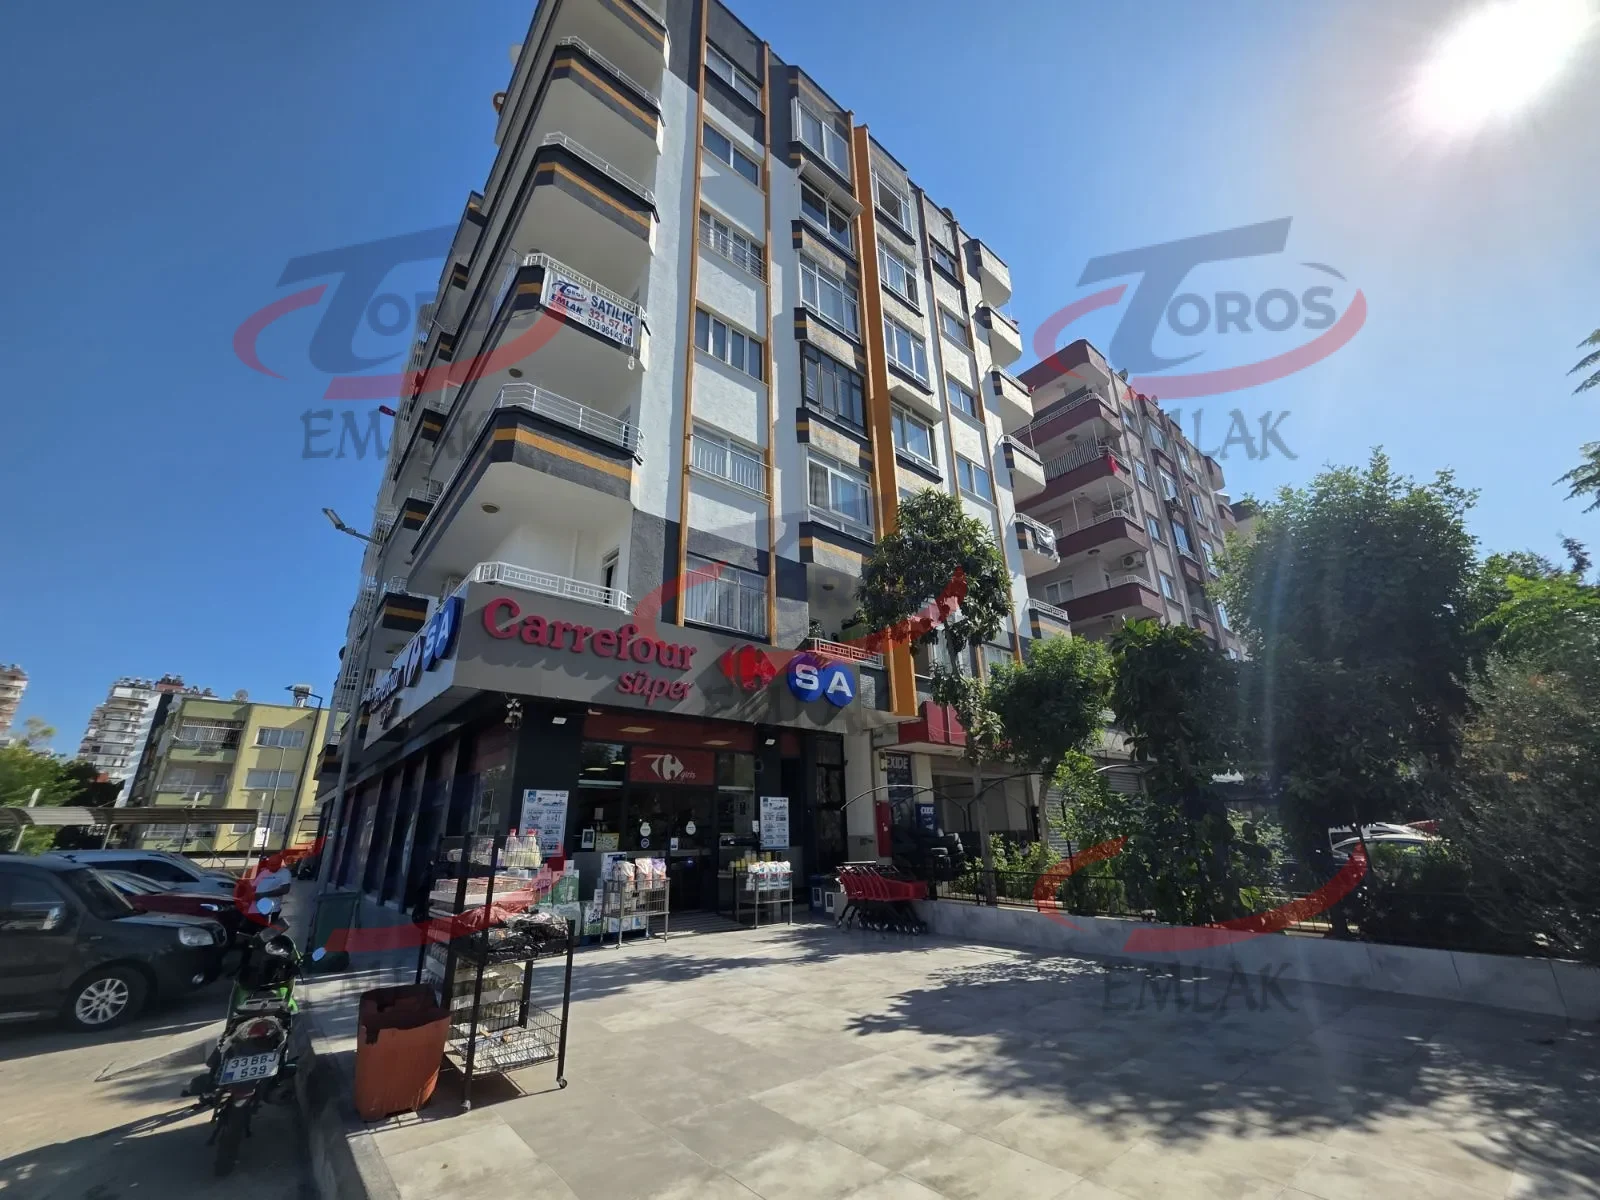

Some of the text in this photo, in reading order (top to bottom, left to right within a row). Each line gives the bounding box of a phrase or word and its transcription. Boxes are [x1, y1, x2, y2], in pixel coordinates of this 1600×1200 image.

[551, 294, 583, 315] EMLAK
[591, 295, 634, 326] SATILIK
[589, 309, 605, 323] 321
[608, 319, 620, 330] 57
[483, 597, 699, 669] Carrefour
[617, 668, 694, 705] süper
[886, 756, 909, 770] EXIDE
[231, 1058, 248, 1069] 33
[240, 1065, 267, 1078] 539
